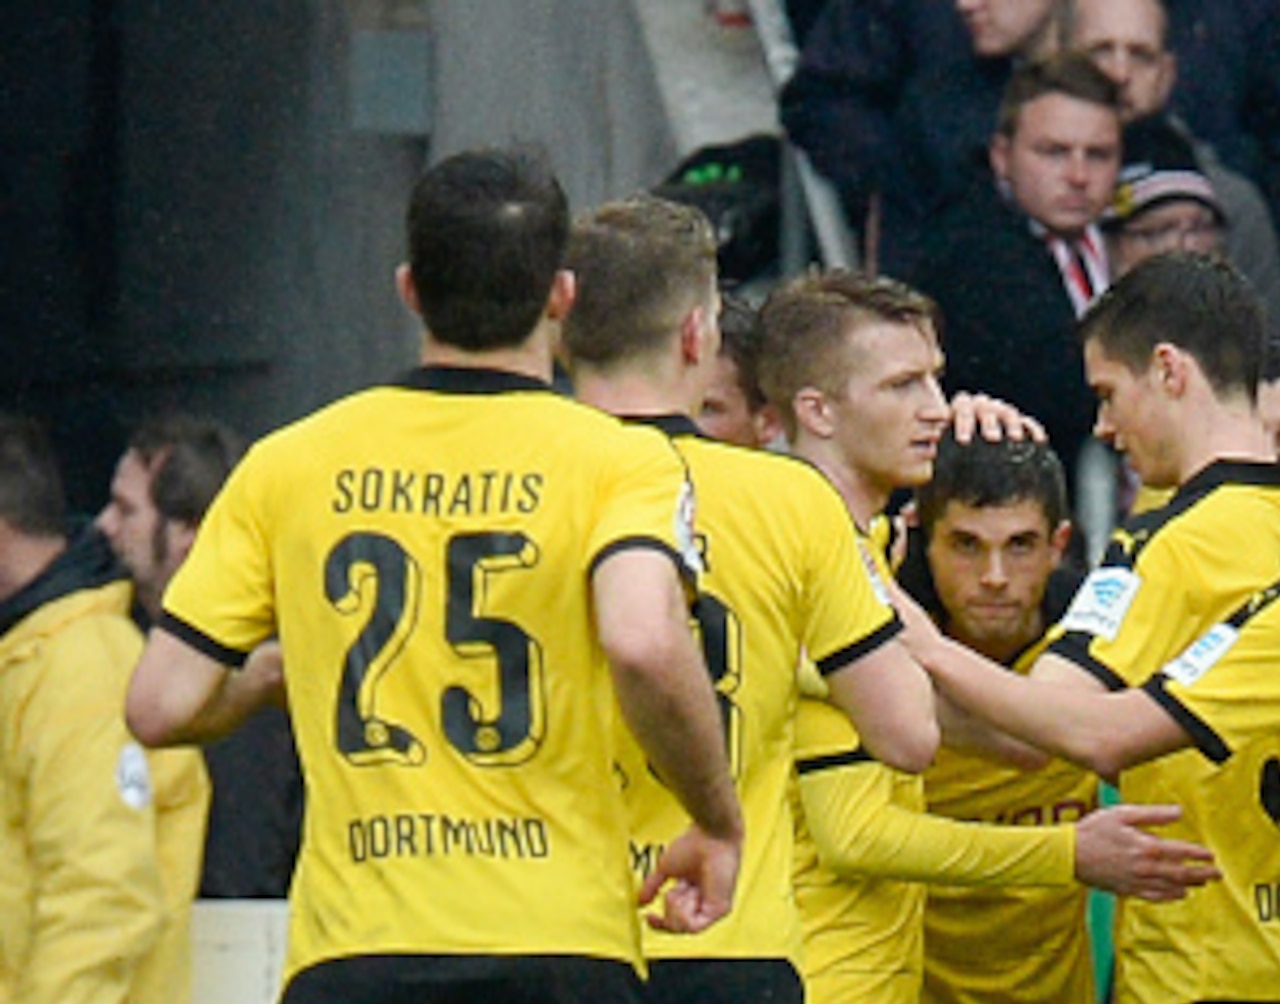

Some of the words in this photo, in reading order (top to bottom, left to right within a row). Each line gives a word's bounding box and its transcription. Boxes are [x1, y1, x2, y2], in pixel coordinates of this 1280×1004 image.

[333, 466, 543, 517] SOKRATIS
[323, 530, 549, 767] 25
[349, 814, 549, 863] DORTMUND
